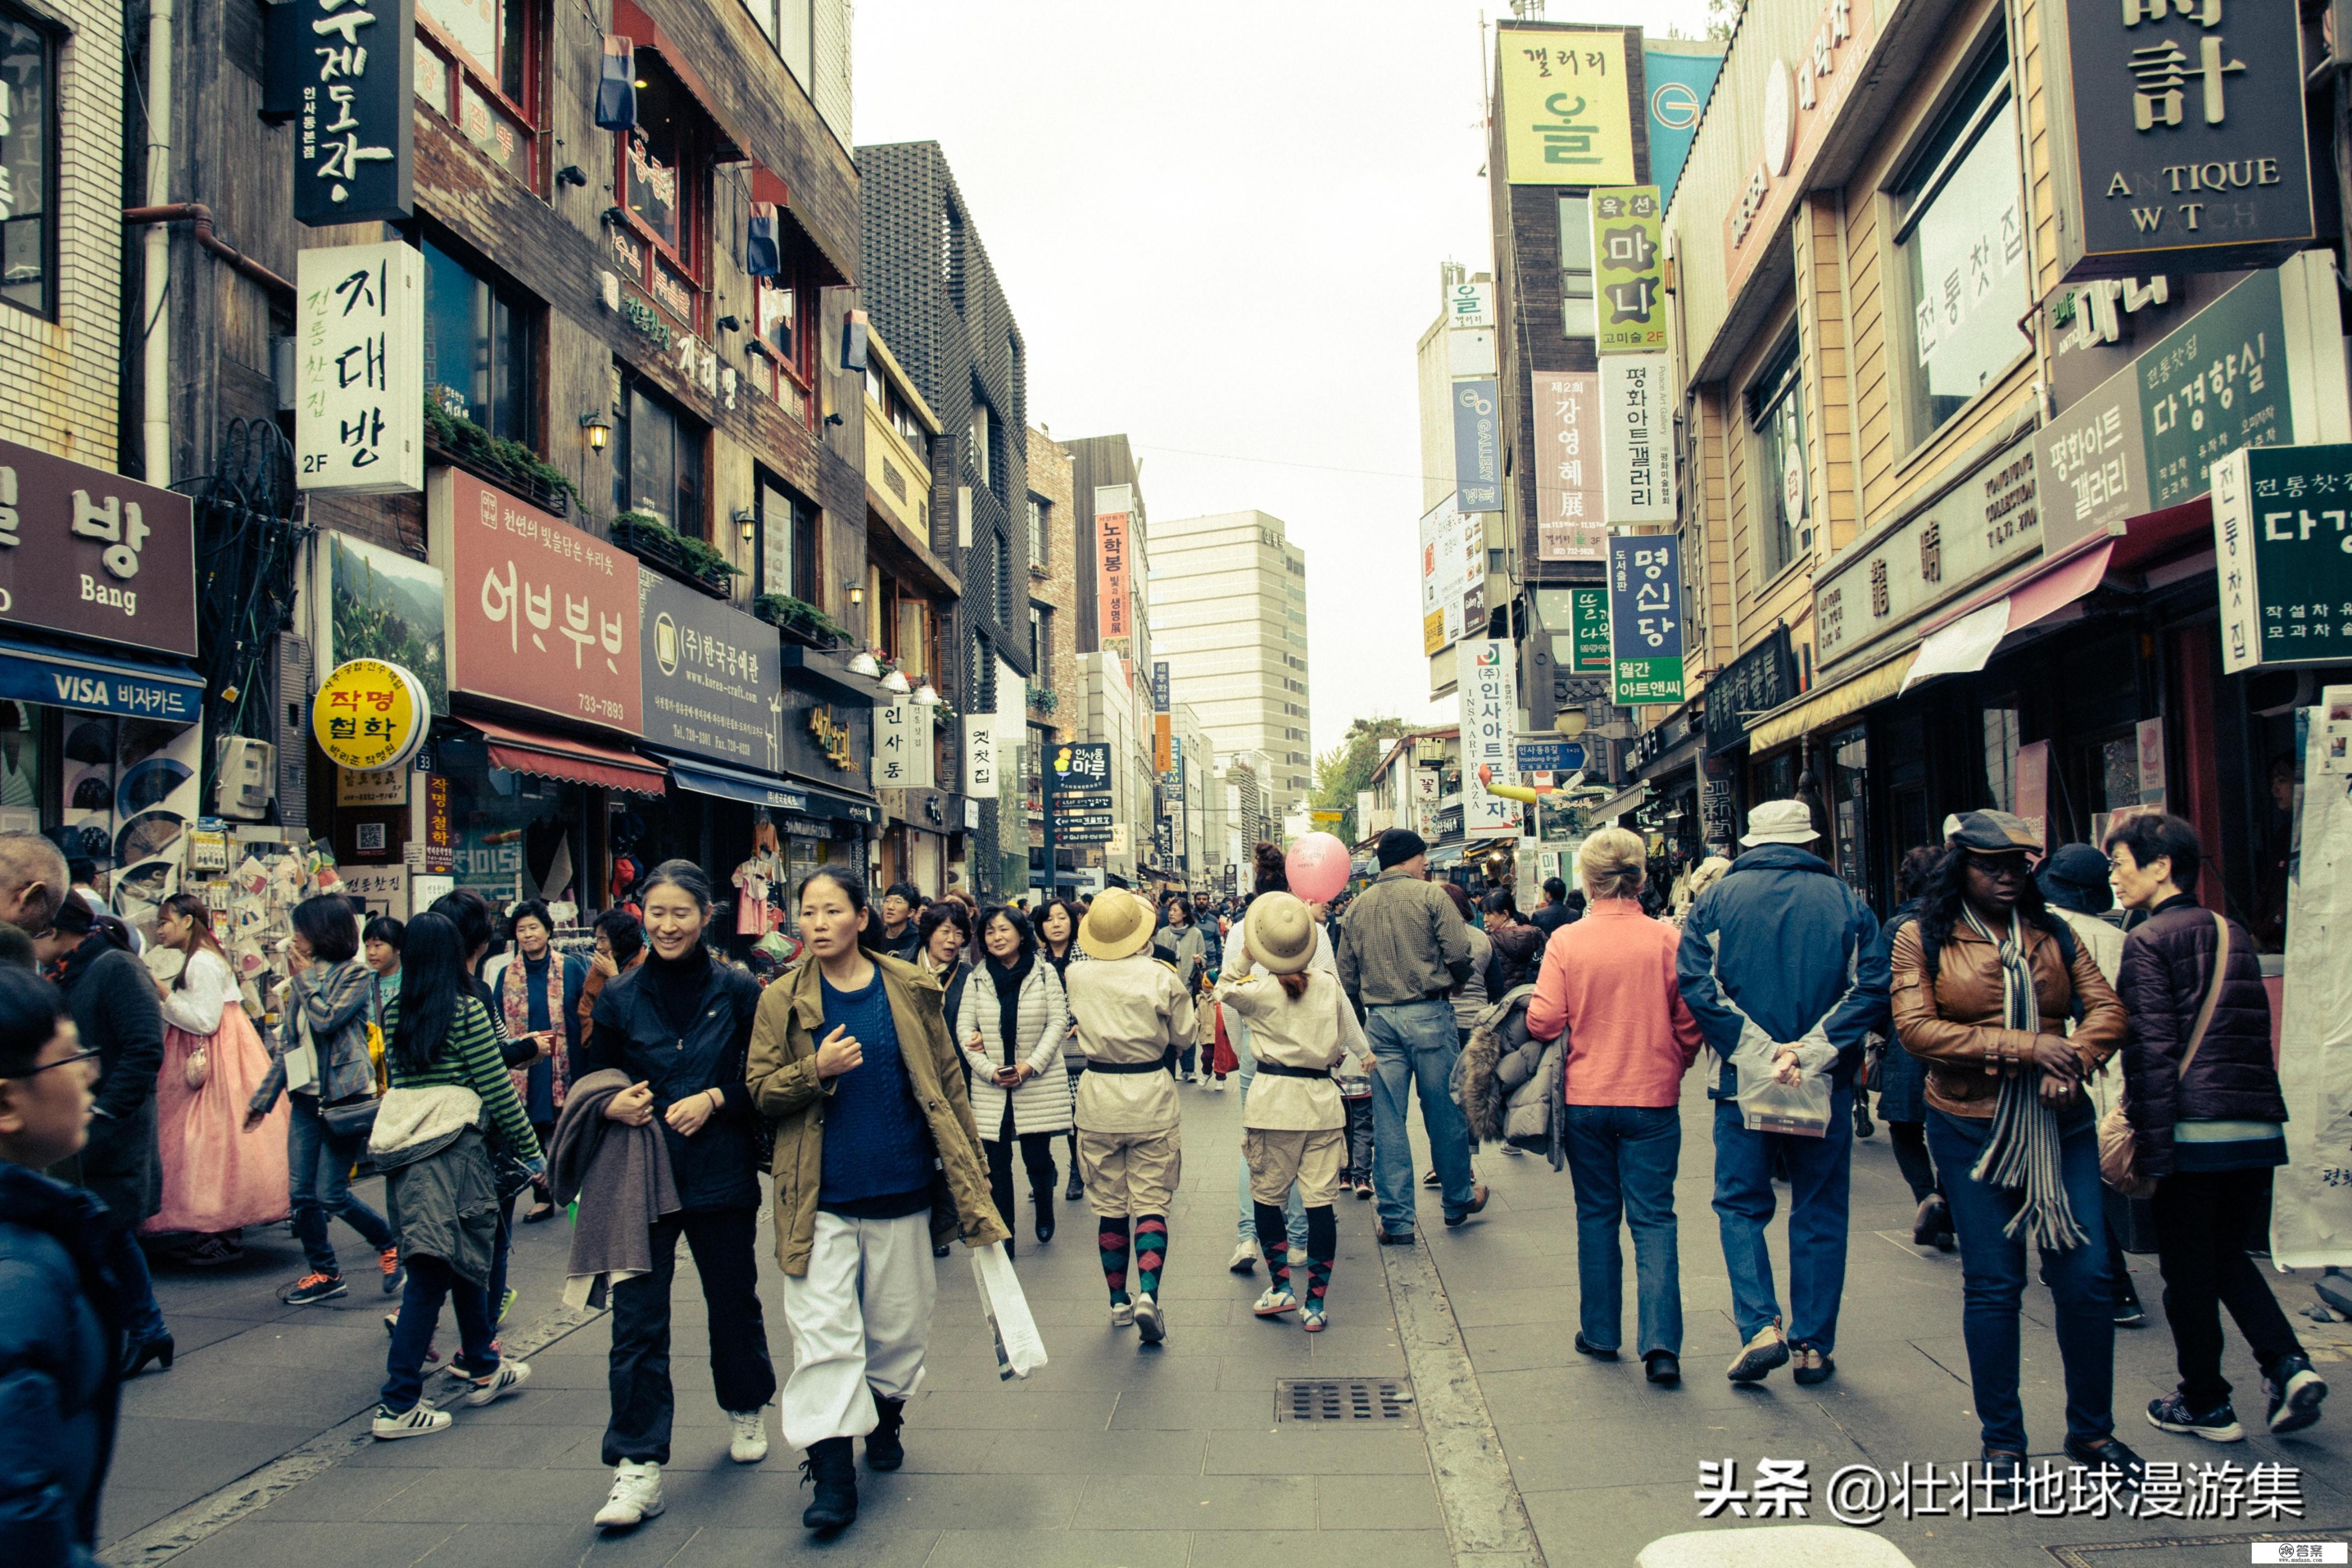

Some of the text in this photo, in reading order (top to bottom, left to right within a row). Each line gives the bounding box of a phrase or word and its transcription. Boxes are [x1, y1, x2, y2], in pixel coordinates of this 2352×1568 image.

[1523, 48, 1605, 77] 갤러리
[303, 86, 316, 159] 인사동본점
[470, 101, 514, 160] 짬뽕
[612, 226, 641, 277] 수육
[1609, 232, 1650, 315] 마니
[1917, 198, 2023, 359] 전통찻집
[307, 287, 330, 417] 전통찻집
[1603, 332, 1664, 344] 고미술 2F
[335, 259, 386, 468] 지대방
[678, 334, 737, 410] 지대방
[2146, 334, 2197, 389] 전통찻집
[1551, 382, 1584, 394] 제2회
[2153, 332, 2266, 437] 다경향실
[1477, 419, 1493, 482] GALLERY
[1626, 367, 1652, 506] 평화아트갤러리
[2048, 404, 2123, 482] 평화아트
[304, 454, 328, 473] 2F
[2070, 452, 2129, 521] 갤러리
[72, 489, 151, 578] 방
[505, 508, 538, 541] 천연의
[541, 526, 582, 562] 빛을담은
[585, 547, 613, 576] 우리옷
[1103, 523, 1122, 572] 노학봉
[1545, 534, 1571, 545] 갤러리
[1615, 550, 1627, 591] 도서출판
[81, 574, 137, 616] Bang
[1634, 547, 1675, 647] 명신당
[2265, 604, 2329, 619] 작설차
[2268, 624, 2330, 638] 모과차
[681, 625, 759, 684] (주)한국공예관
[1619, 661, 1650, 678] 월간
[51, 674, 186, 714] VISA 비자카드
[331, 690, 394, 712] 작명
[578, 693, 624, 720] 733-7893
[686, 670, 758, 704] www.korea-craft.com
[1619, 680, 1681, 698] 아트앤씨
[329, 717, 397, 742] 철학
[885, 706, 903, 778] 인사동
[1478, 668, 1506, 818] (주)인사아트프자
[329, 743, 396, 766] 박리준 작명원
[420, 755, 431, 769] 33
[973, 730, 990, 783] 옛찻집
[1072, 759, 1106, 780] 마루
[1075, 748, 1104, 760] 인사동
[1519, 746, 1558, 755] 인사동8길
[1088, 798, 1109, 807] 김치간
[1420, 778, 1434, 794] 꽃
[346, 876, 400, 893] 전통찻집
